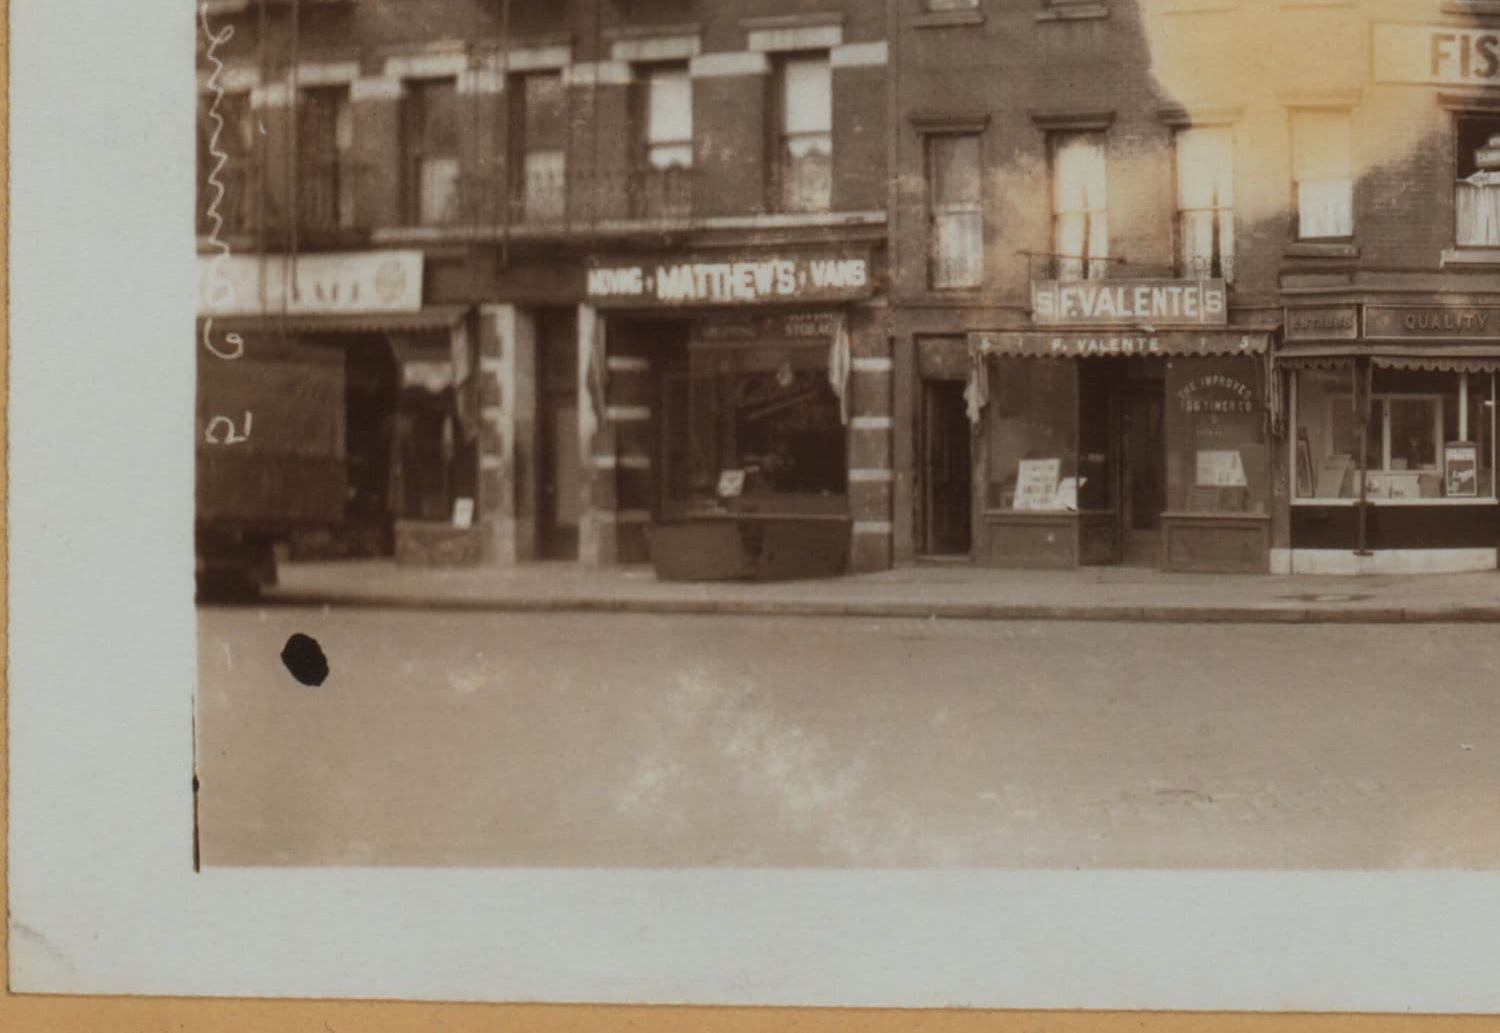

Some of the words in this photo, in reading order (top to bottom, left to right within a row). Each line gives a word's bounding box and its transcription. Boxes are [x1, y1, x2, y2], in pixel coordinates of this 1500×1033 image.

[810, 259, 868, 288] VANS
[1404, 313, 1490, 334] QUALITY
[1077, 336, 1160, 352] VALENTE
